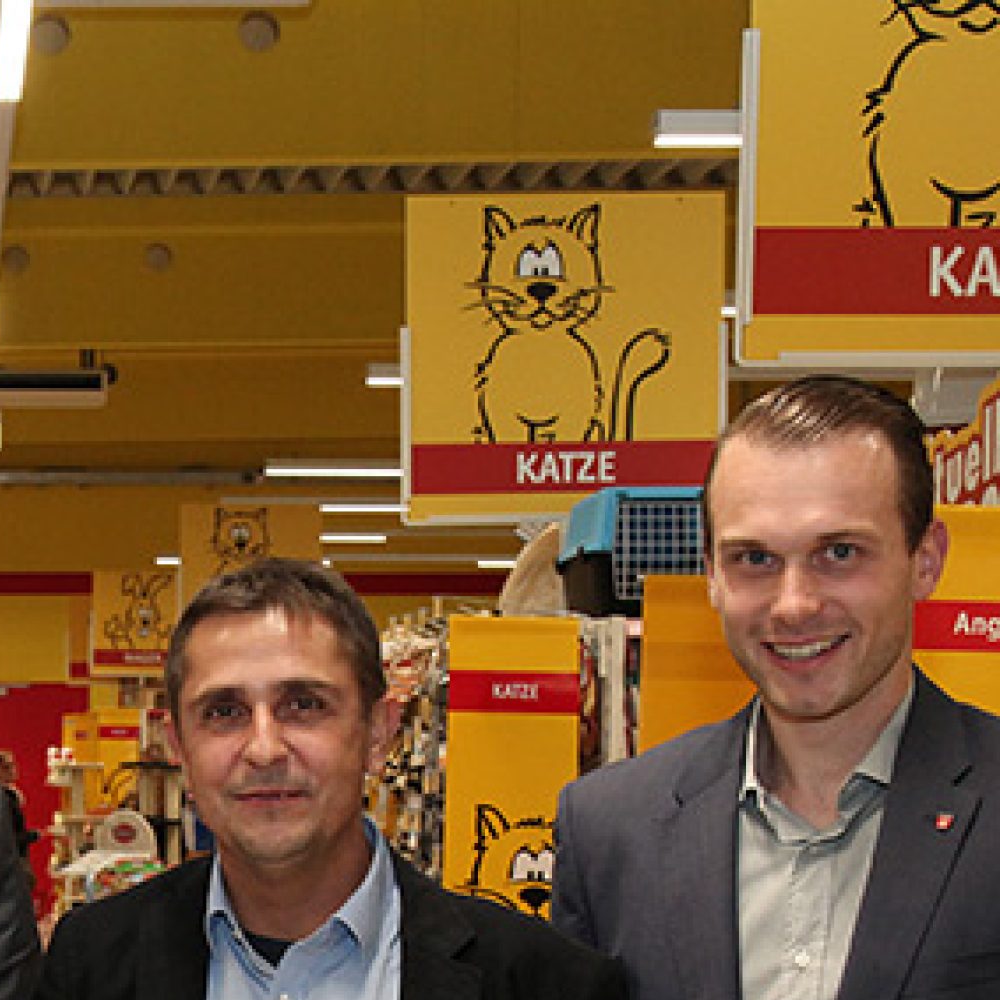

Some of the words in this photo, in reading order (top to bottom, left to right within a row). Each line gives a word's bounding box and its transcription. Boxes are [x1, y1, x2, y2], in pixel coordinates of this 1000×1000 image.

[929, 246, 1000, 297] KA
[516, 451, 617, 484] KATZE
[491, 681, 539, 700] KATZE
